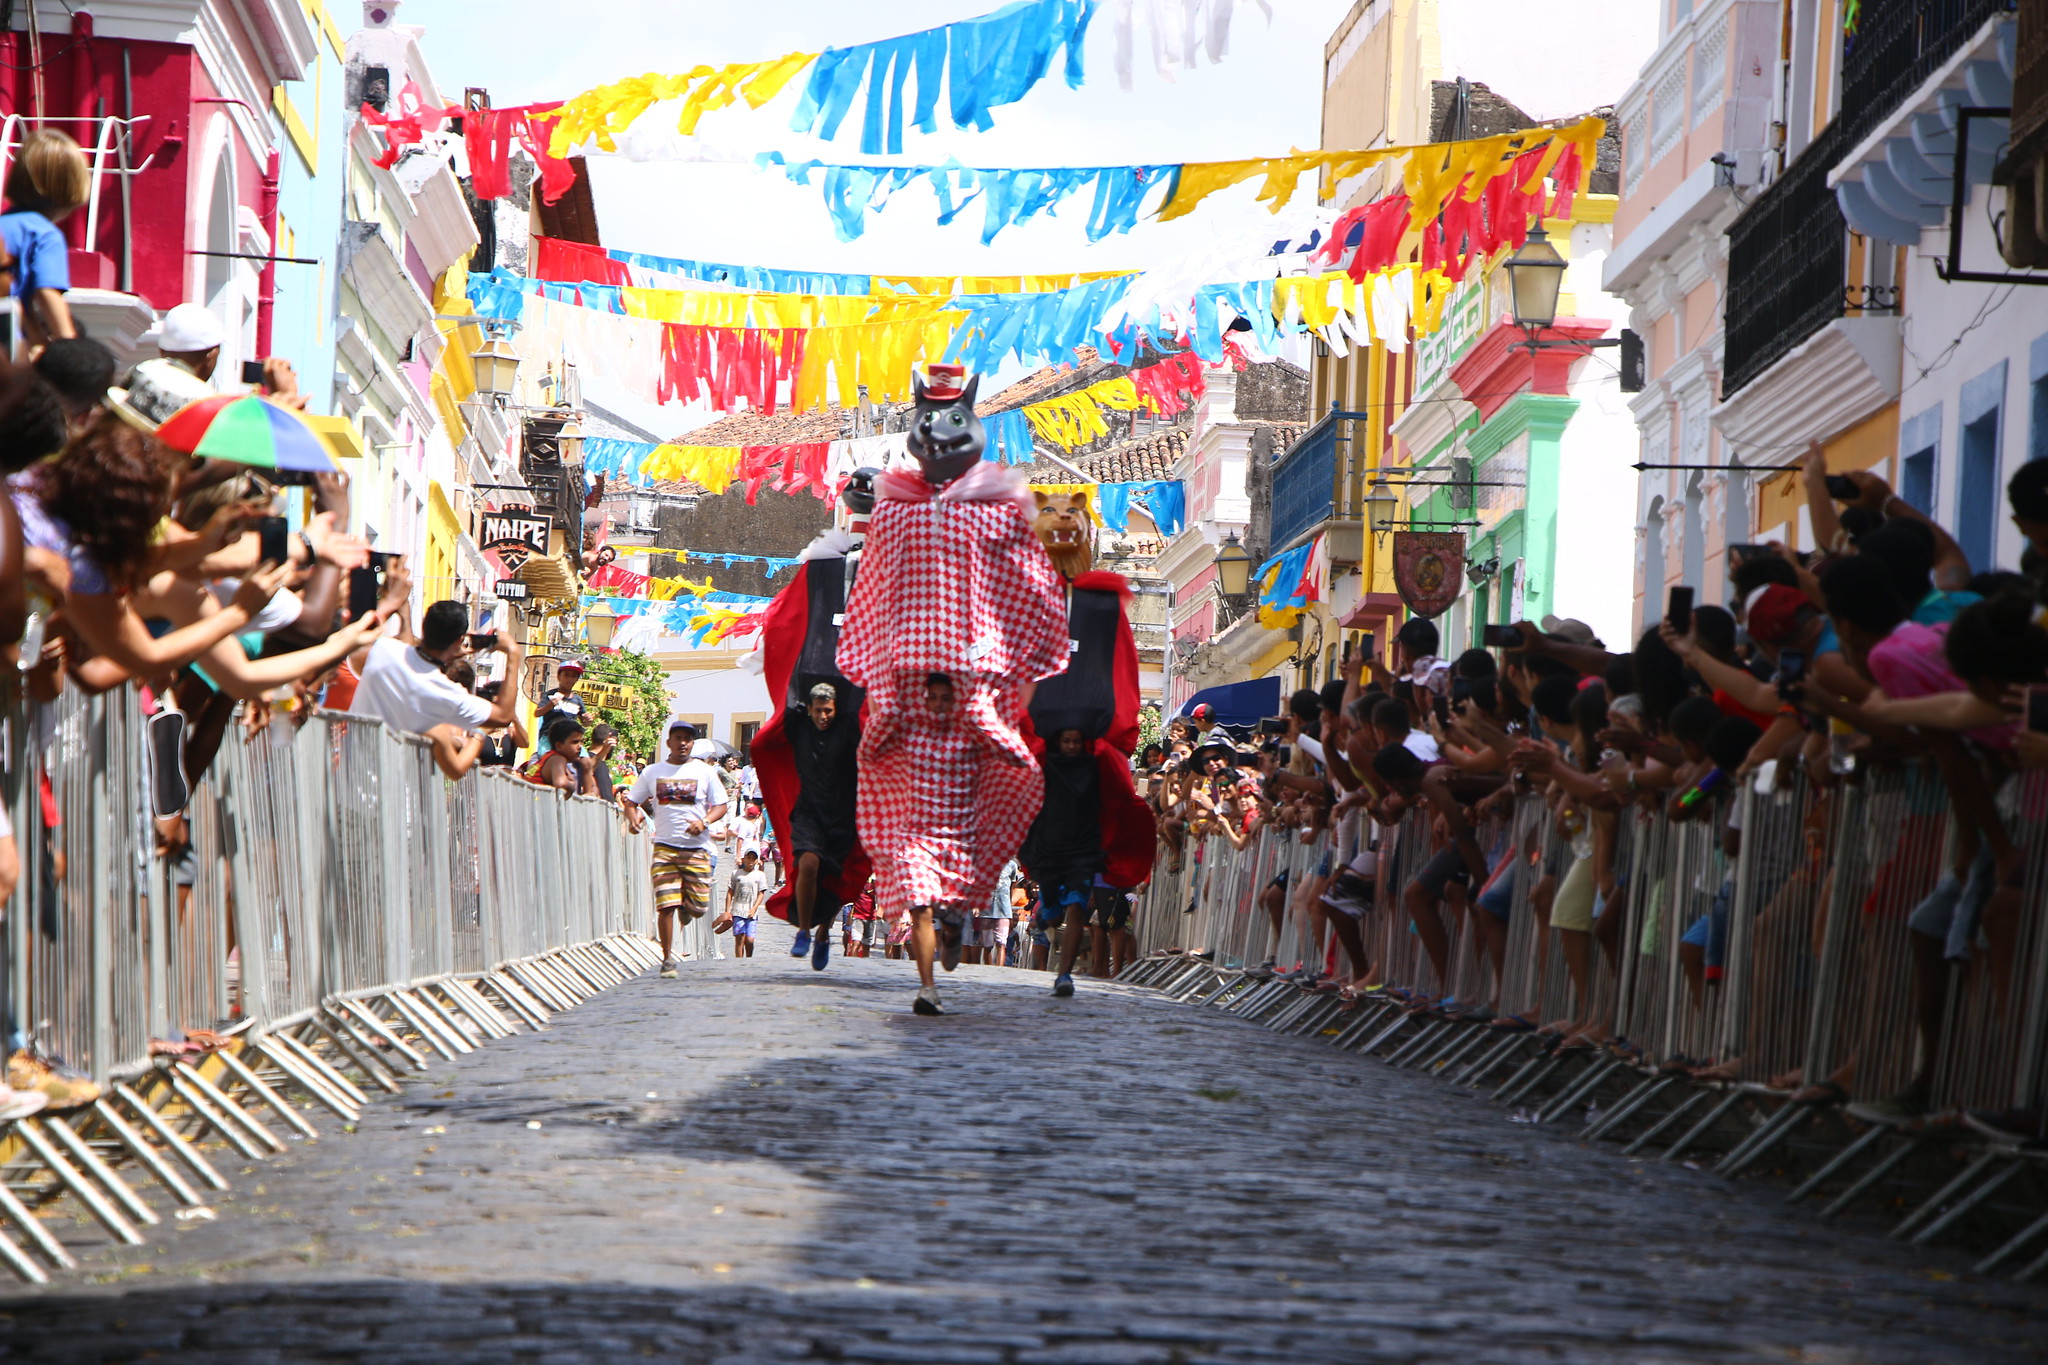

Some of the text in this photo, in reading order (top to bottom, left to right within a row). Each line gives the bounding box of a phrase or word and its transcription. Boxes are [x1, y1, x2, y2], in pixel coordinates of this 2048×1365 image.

[484, 517, 547, 550] NAIPE
[496, 582, 526, 597] TATTOO
[605, 694, 630, 710] BIU
